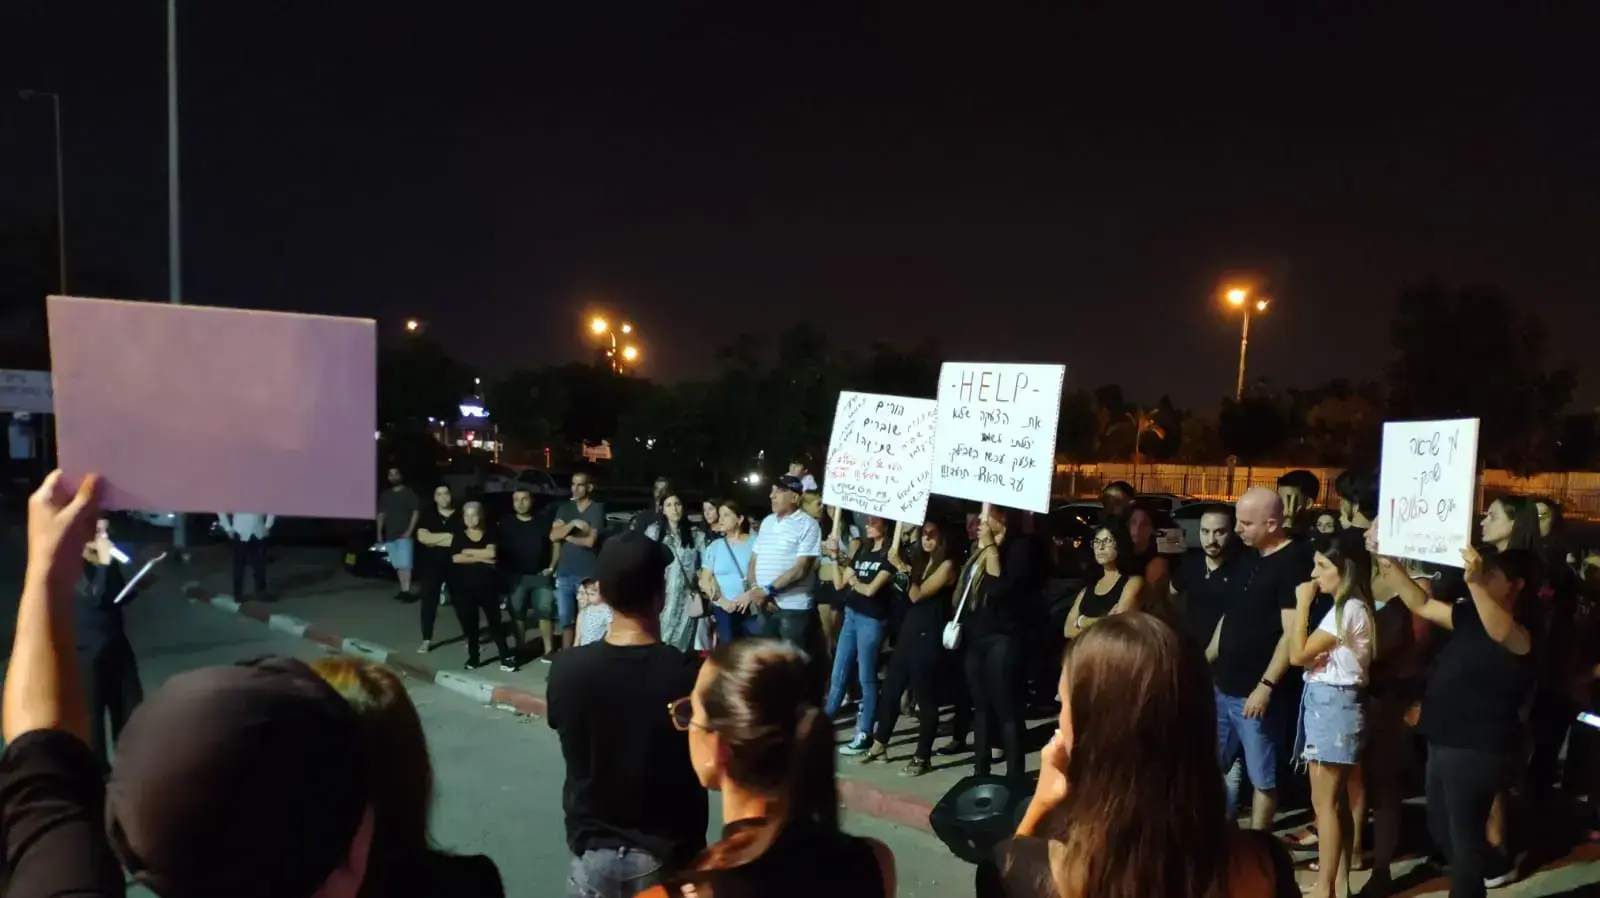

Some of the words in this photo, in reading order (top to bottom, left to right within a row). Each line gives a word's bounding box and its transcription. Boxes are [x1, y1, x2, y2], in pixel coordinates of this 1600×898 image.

[876, 400, 905, 416] הורים
[952, 405, 971, 420] שלא
[979, 408, 1010, 428] הצעקה
[1021, 415, 1042, 430] את
[864, 417, 902, 436] שוברים
[1011, 456, 1036, 472] אצעק
[1010, 477, 1025, 492] עד
